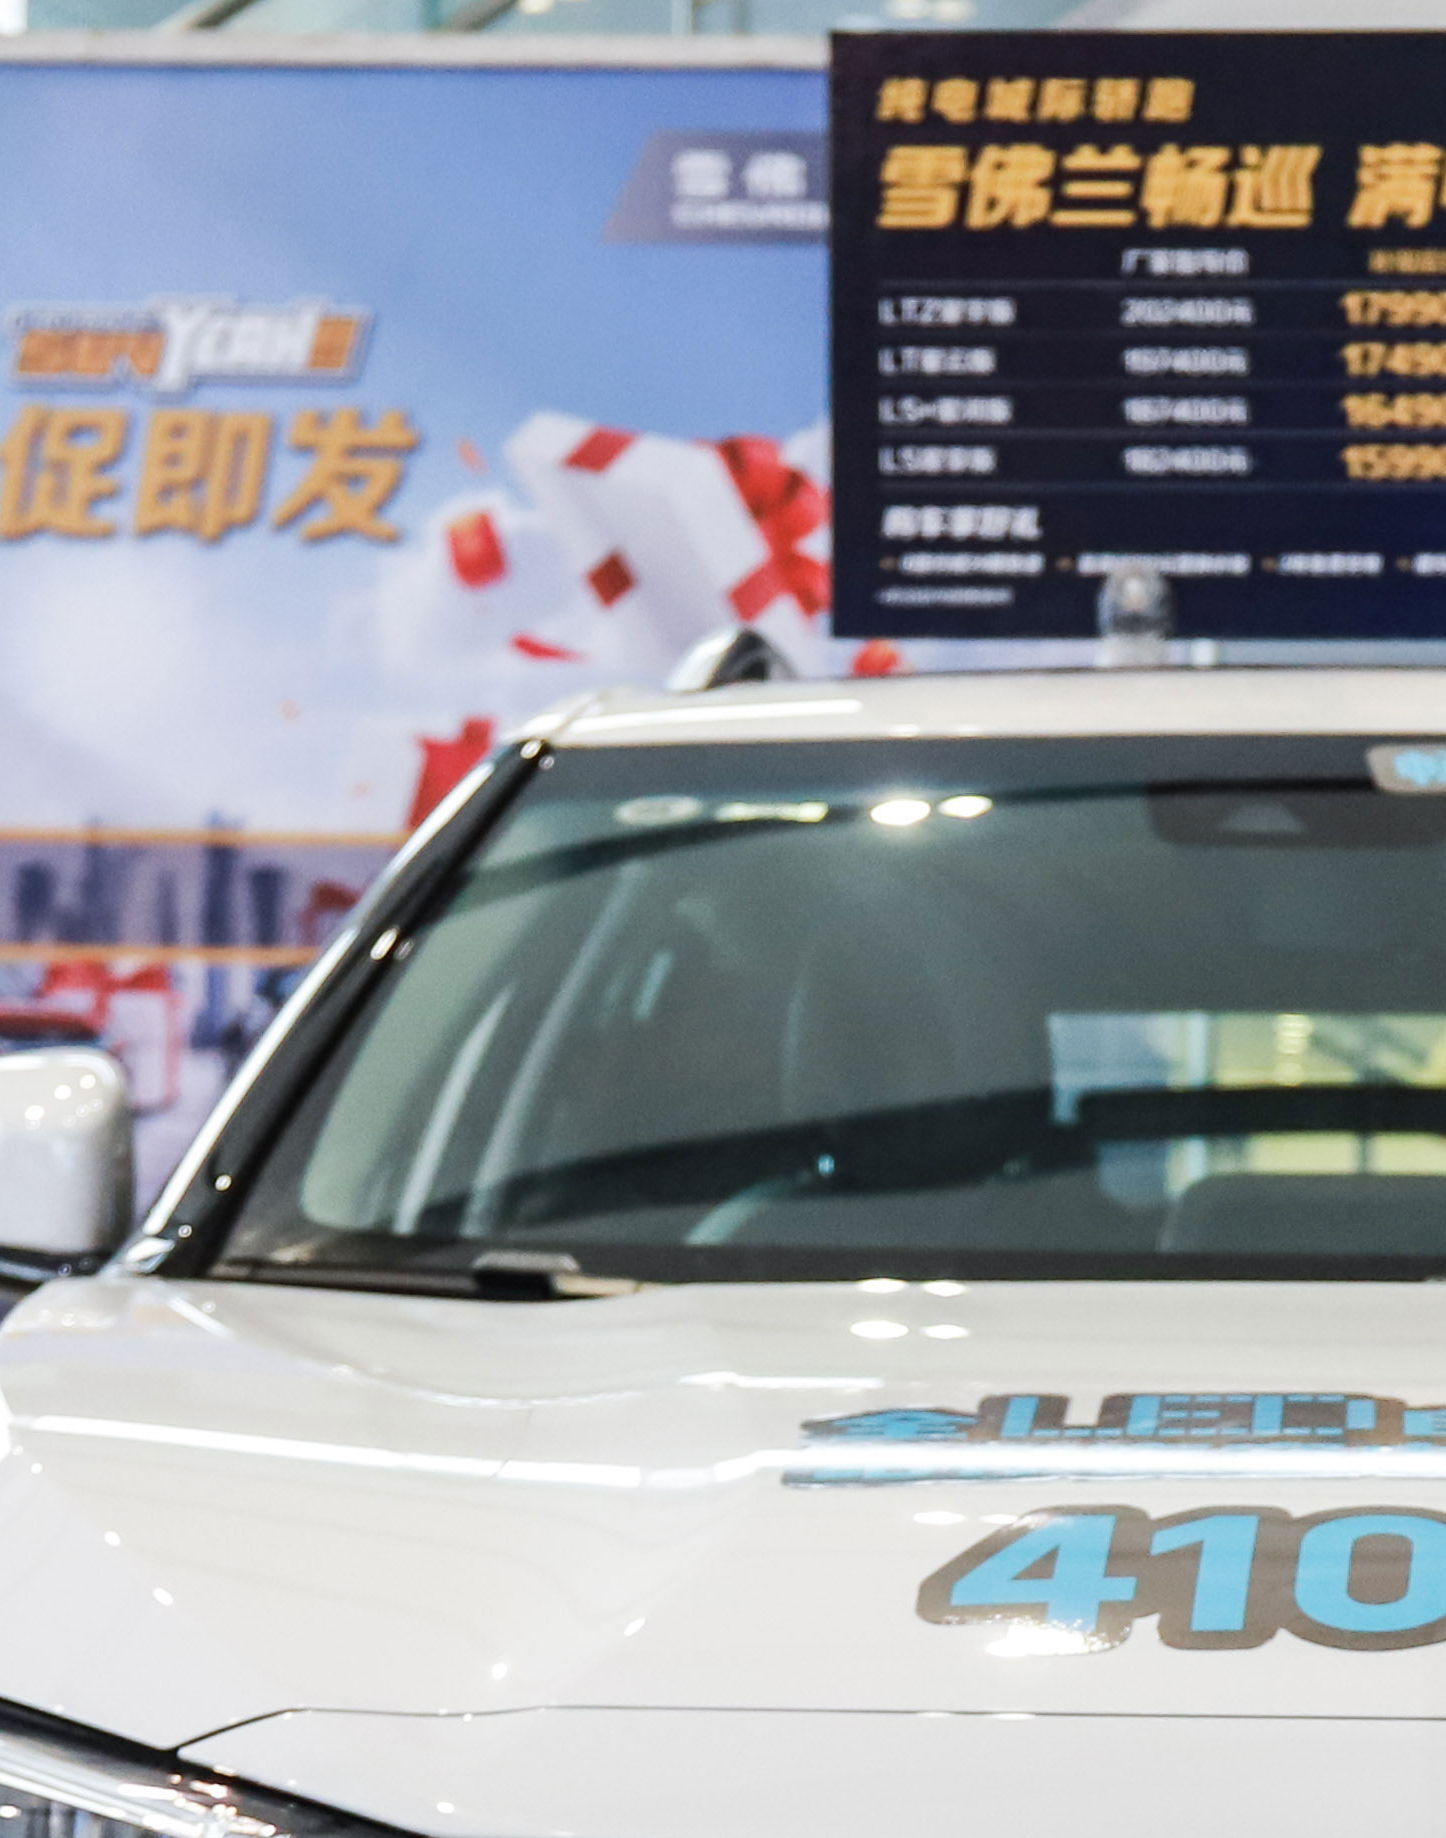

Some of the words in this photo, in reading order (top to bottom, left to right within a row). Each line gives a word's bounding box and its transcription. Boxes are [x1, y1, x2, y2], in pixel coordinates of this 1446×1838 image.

[875, 144, 1322, 230] 雪佛兰畅巡
